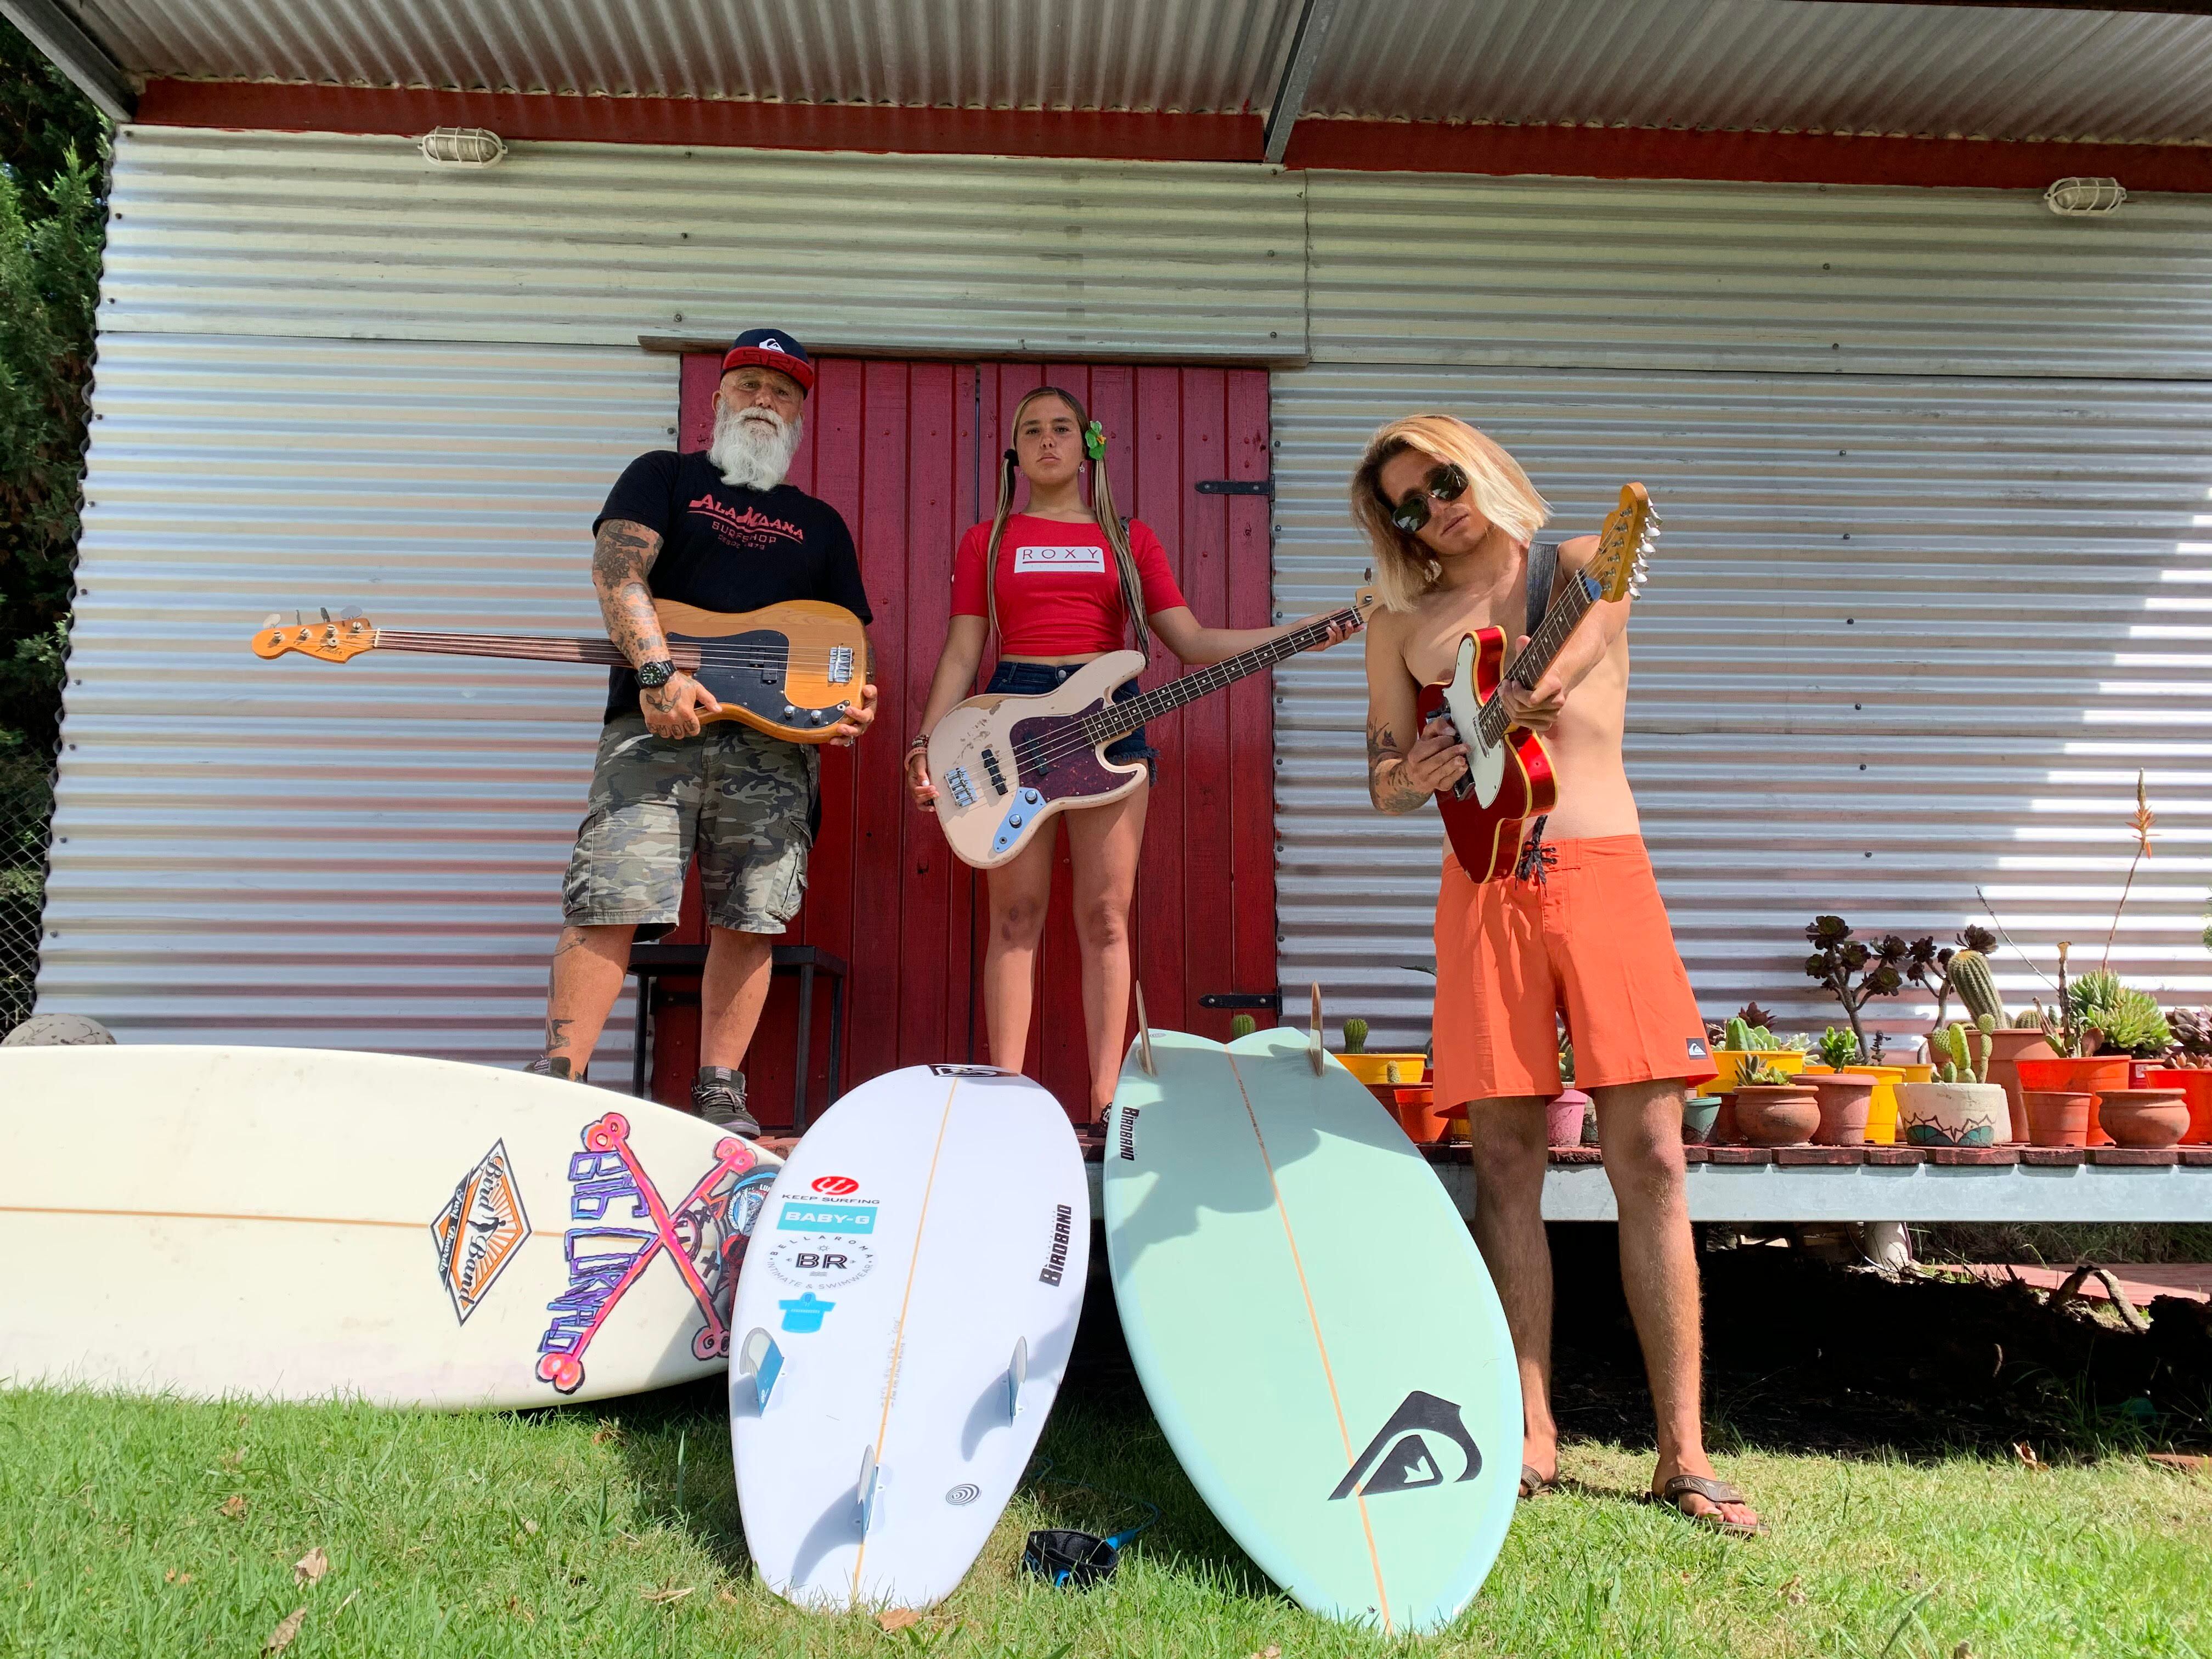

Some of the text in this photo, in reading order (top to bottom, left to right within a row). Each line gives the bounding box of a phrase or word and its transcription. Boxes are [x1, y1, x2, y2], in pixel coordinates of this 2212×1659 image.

[712, 520, 777, 544] SURFSHOP
[1023, 548, 1098, 560] ROXY
[785, 1211, 870, 1224] BABY-G
[438, 1188, 465, 1273] Surf Boards
[458, 1155, 505, 1307] Bird Band
[770, 1235, 873, 1259] BELLAROMA
[795, 1252, 848, 1269] BR
[767, 1261, 803, 1288] INTIMATE
[818, 1263, 874, 1289] SWIMWEAR
